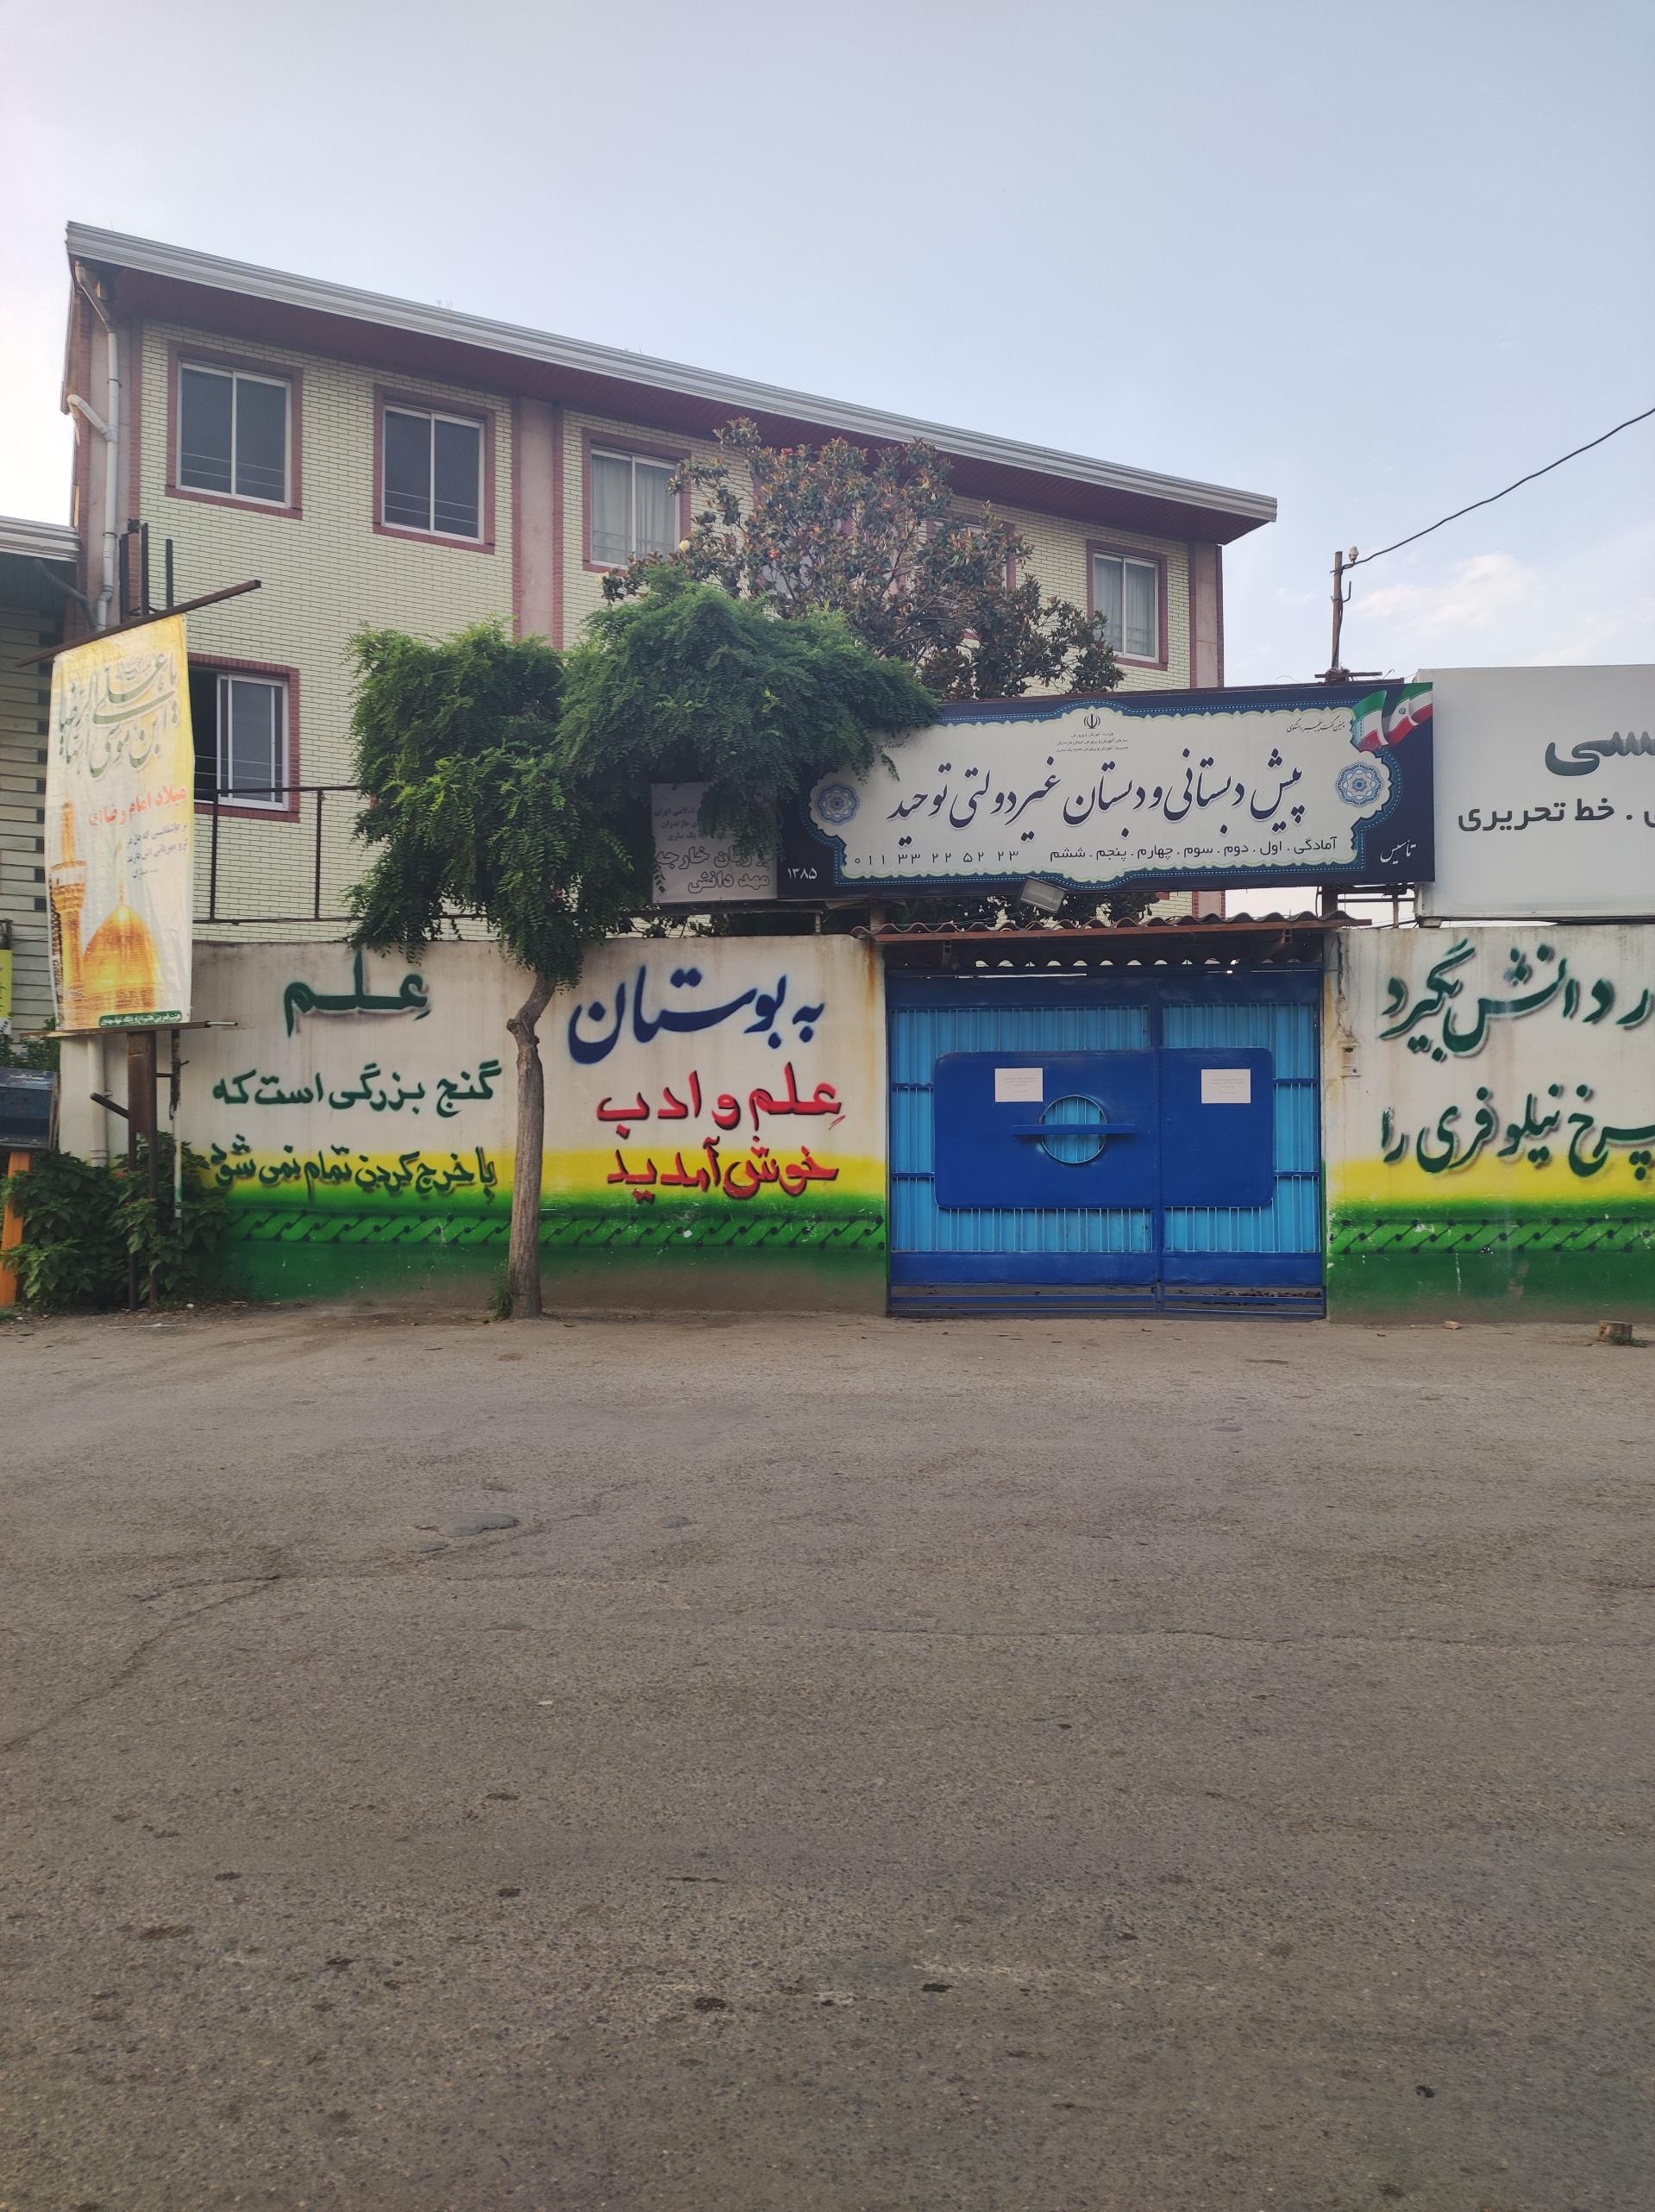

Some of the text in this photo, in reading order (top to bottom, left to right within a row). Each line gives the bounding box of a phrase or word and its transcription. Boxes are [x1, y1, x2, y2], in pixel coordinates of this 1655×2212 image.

[129, 790, 153, 822] امام
[155, 785, 187, 807] میلاد
[885, 761, 953, 848] توحید
[1062, 760, 1148, 840] دبستان
[1147, 785, 1163, 810] و
[1162, 745, 1246, 837] دبستانی
[1250, 745, 1306, 833] پیش
[1575, 797, 1615, 822] خط
[1458, 802, 1566, 832] تحریری
[655, 844, 711, 871] خارجه
[1049, 835, 1338, 862] آمادگی اول دوم سوم چهارم پنجم ششم
[687, 869, 770, 894] مهد دانش
[787, 866, 818, 881] ۱۳۸۵
[567, 964, 826, 1066] به بوستان
[1379, 937, 1616, 1063] دانش بگیرد
[212, 1058, 503, 1119] گنج بزرگی است که
[595, 1069, 702, 1140] ادب
[710, 1093, 741, 1131] و
[1379, 1106, 1409, 1164] را
[304, 1144, 353, 1205] تمام
[354, 1150, 421, 1194] کردن
[415, 1151, 476, 1195] خرج
[476, 1145, 498, 1199] با
[606, 1135, 840, 1205] خوش آمدید
